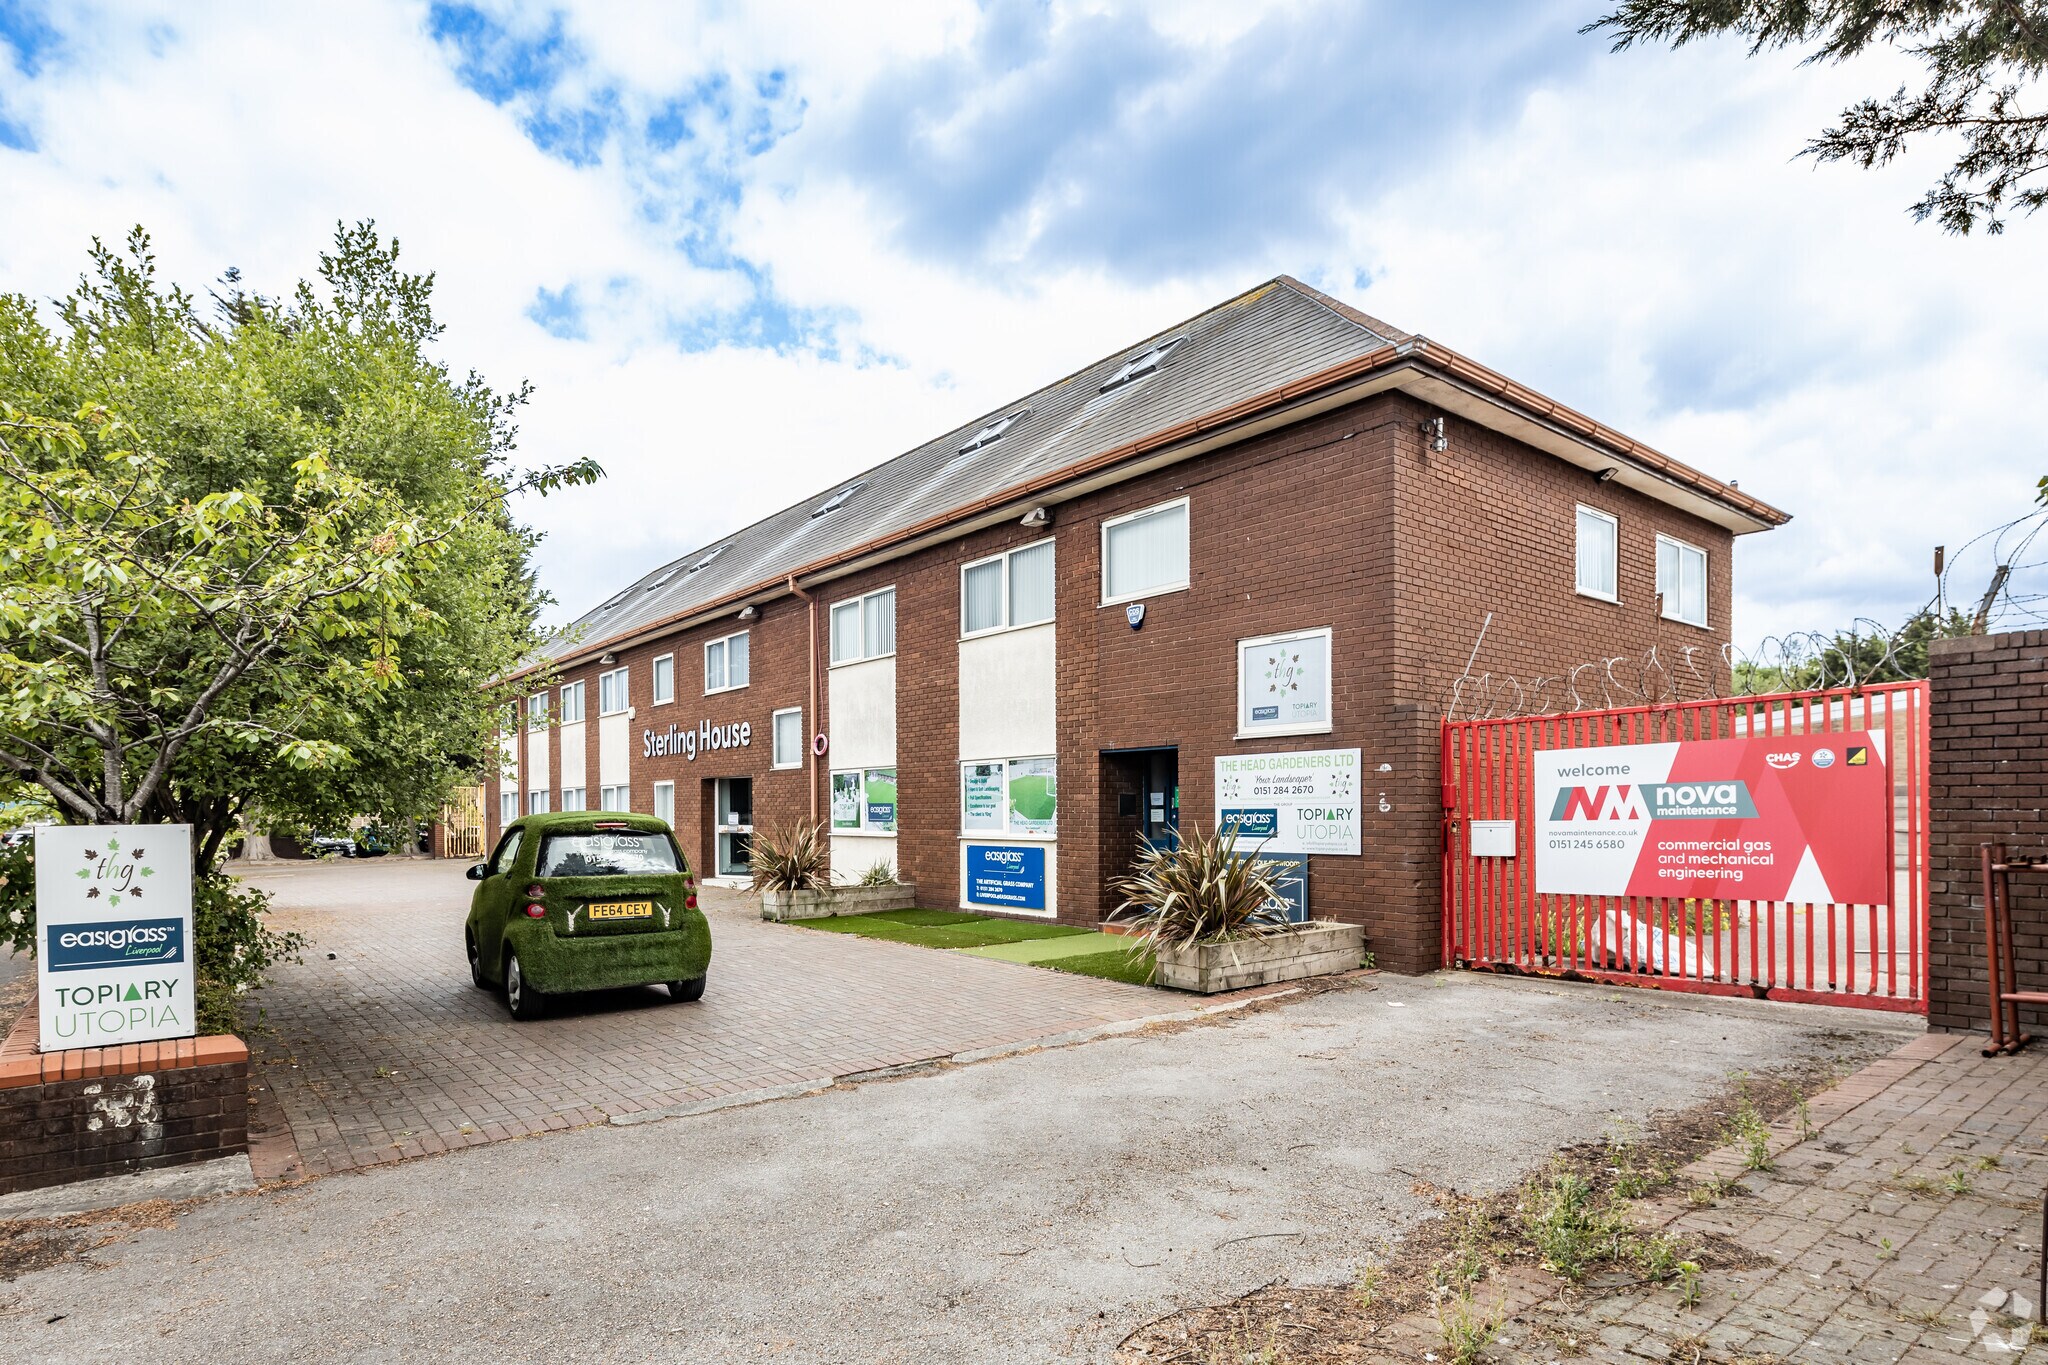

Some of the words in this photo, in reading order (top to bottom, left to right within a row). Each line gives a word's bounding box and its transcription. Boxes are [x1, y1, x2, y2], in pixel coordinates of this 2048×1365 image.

[1275, 658, 1294, 687] thg
[643, 723, 696, 761] Sterling
[700, 718, 751, 751] House
[1220, 760, 1238, 772] THE
[1240, 759, 1266, 771] HEAD
[1269, 755, 1331, 770] GARDENERS
[1334, 754, 1354, 767] LTD
[1765, 752, 1801, 762] CHAS
[1557, 764, 1631, 778] welcome
[1253, 787, 1271, 795] 0151
[1273, 786, 1289, 795] 284
[1292, 785, 1314, 794] 2670
[1656, 784, 1737, 806] nova
[1297, 808, 1354, 820] TOPIARY
[1656, 806, 1738, 816] maintenance
[1297, 825, 1354, 840] UTOPIA
[1549, 840, 1571, 849] 0151
[1574, 840, 1594, 849] 245
[1596, 840, 1625, 849] 6580
[1657, 839, 1740, 851] commercial
[1743, 840, 1772, 853] gas
[1658, 853, 1685, 864] and
[1688, 853, 1774, 866] mechanical
[97, 851, 134, 892] thg
[1658, 867, 1744, 882] engineering
[594, 904, 623, 916] FE64
[626, 904, 648, 915] CEY
[125, 944, 162, 956] Liverpool
[55, 978, 179, 1008] TOPIARY
[56, 1005, 180, 1037] UTOPIA
